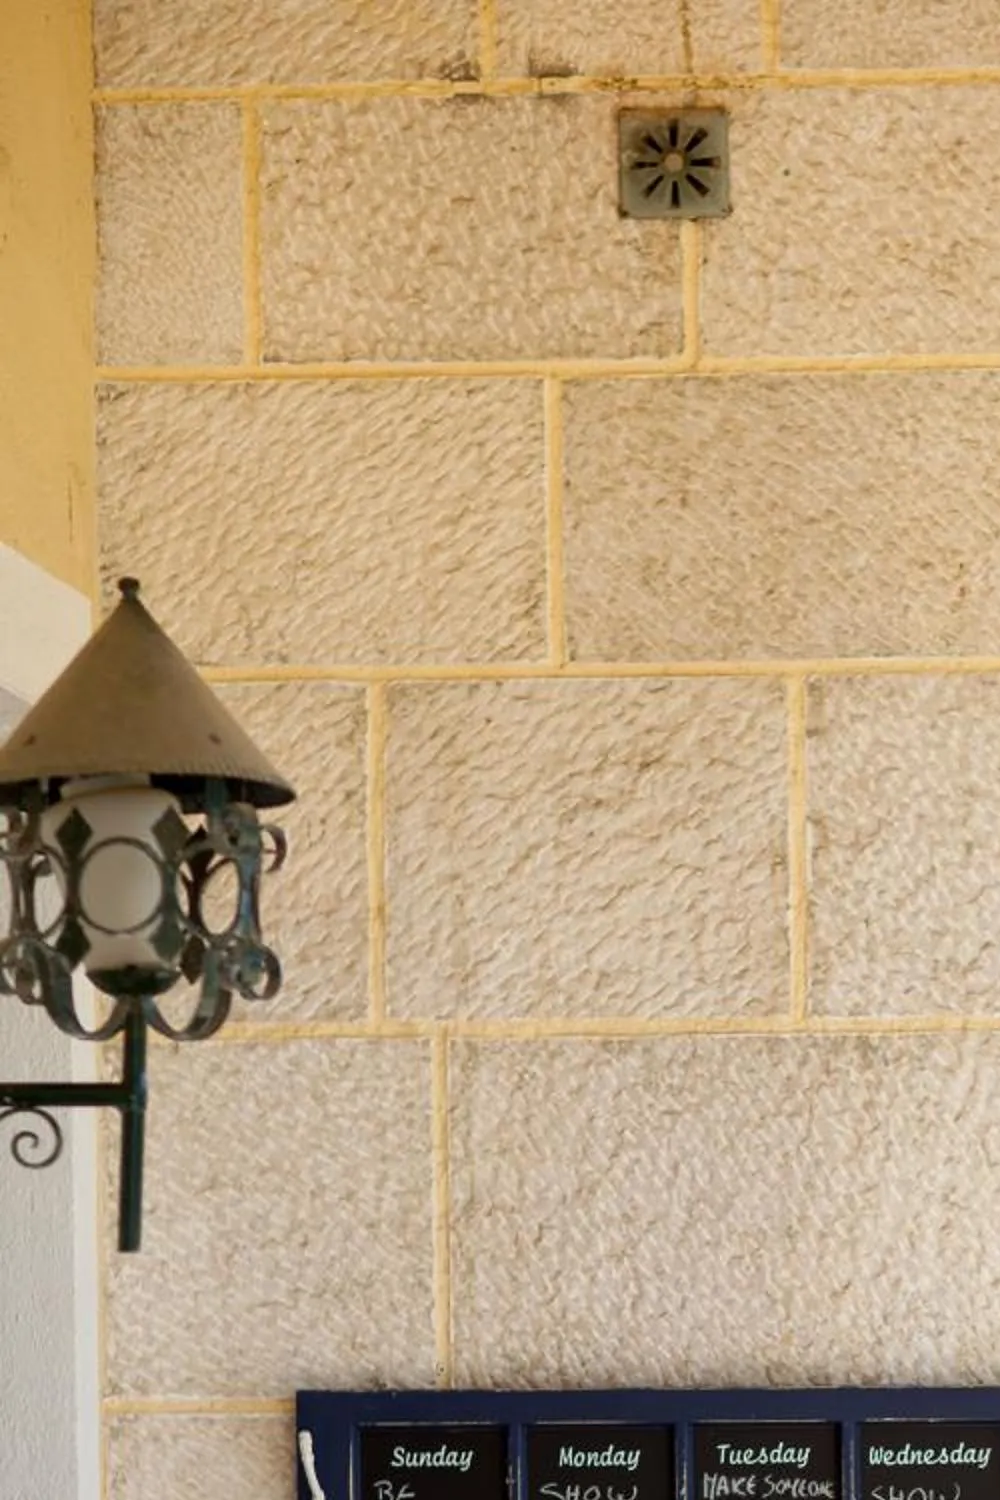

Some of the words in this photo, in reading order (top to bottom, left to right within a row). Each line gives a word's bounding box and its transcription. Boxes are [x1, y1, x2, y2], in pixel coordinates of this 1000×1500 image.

[391, 1445, 474, 1471] Sunday
[559, 1445, 640, 1471] Monday
[716, 1442, 810, 1468] Tuesday
[869, 1442, 992, 1469] Wednesday
[703, 1472, 757, 1500] MAKE
